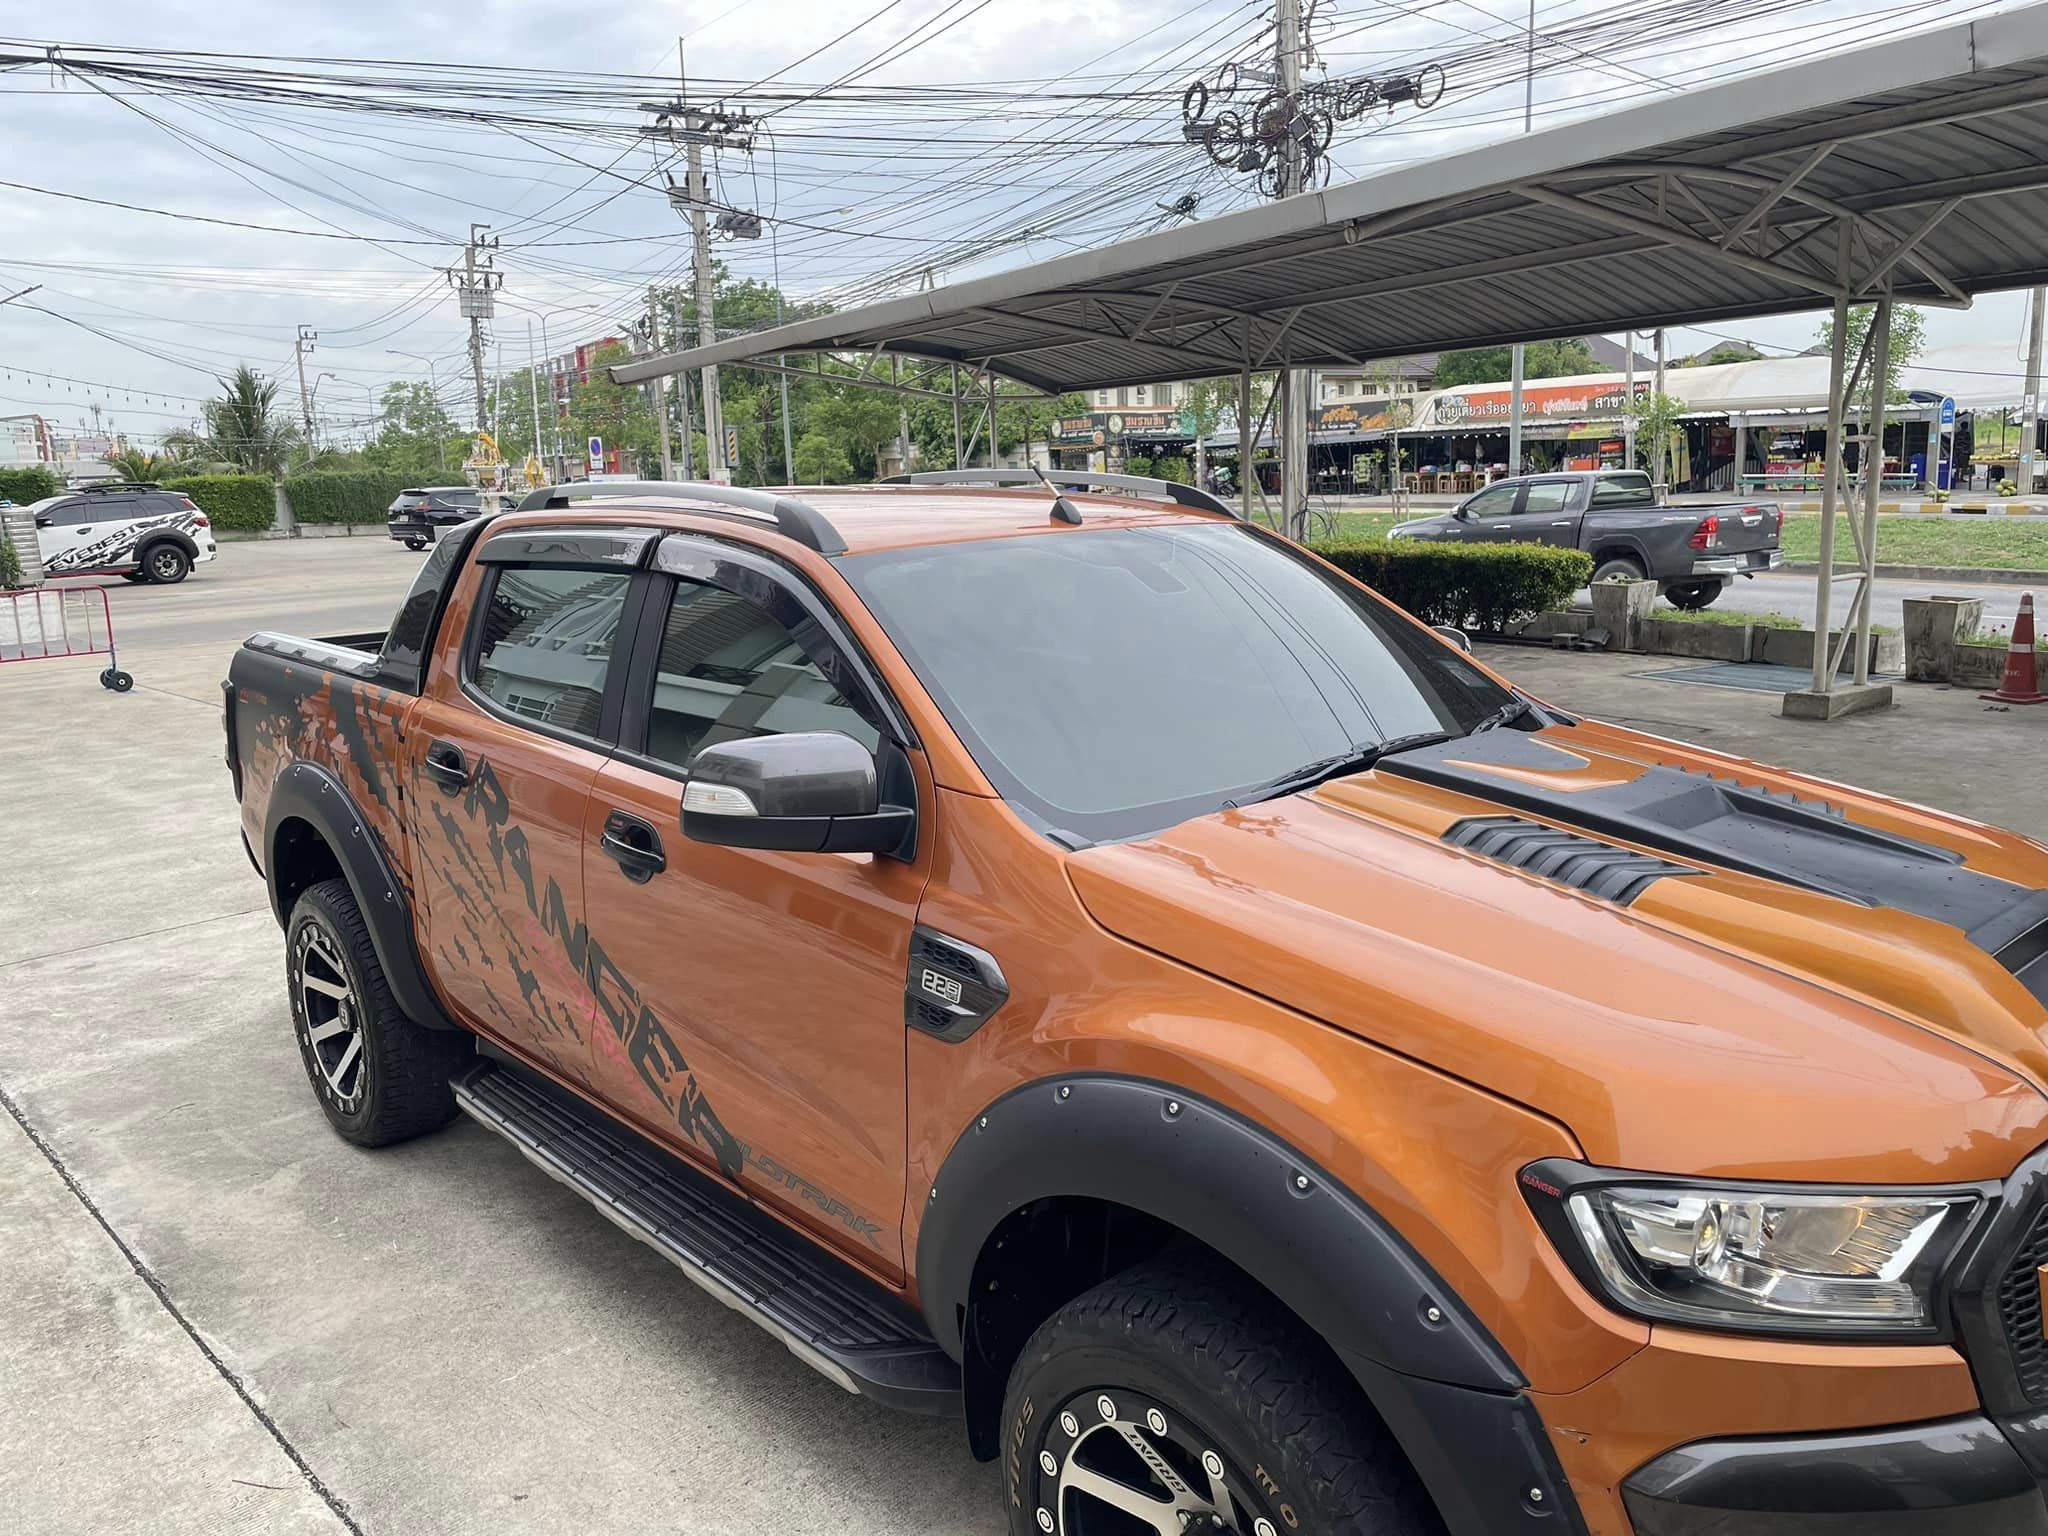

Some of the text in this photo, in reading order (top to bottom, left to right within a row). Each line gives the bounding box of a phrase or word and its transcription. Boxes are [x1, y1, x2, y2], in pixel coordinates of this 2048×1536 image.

[1594, 395, 1626, 409] สาขา
[51, 522, 139, 571] EVEREST
[464, 754, 744, 1183] RANGER
[1522, 1174, 1562, 1199] RANGER
[1123, 1431, 1188, 1495] GRUNT
